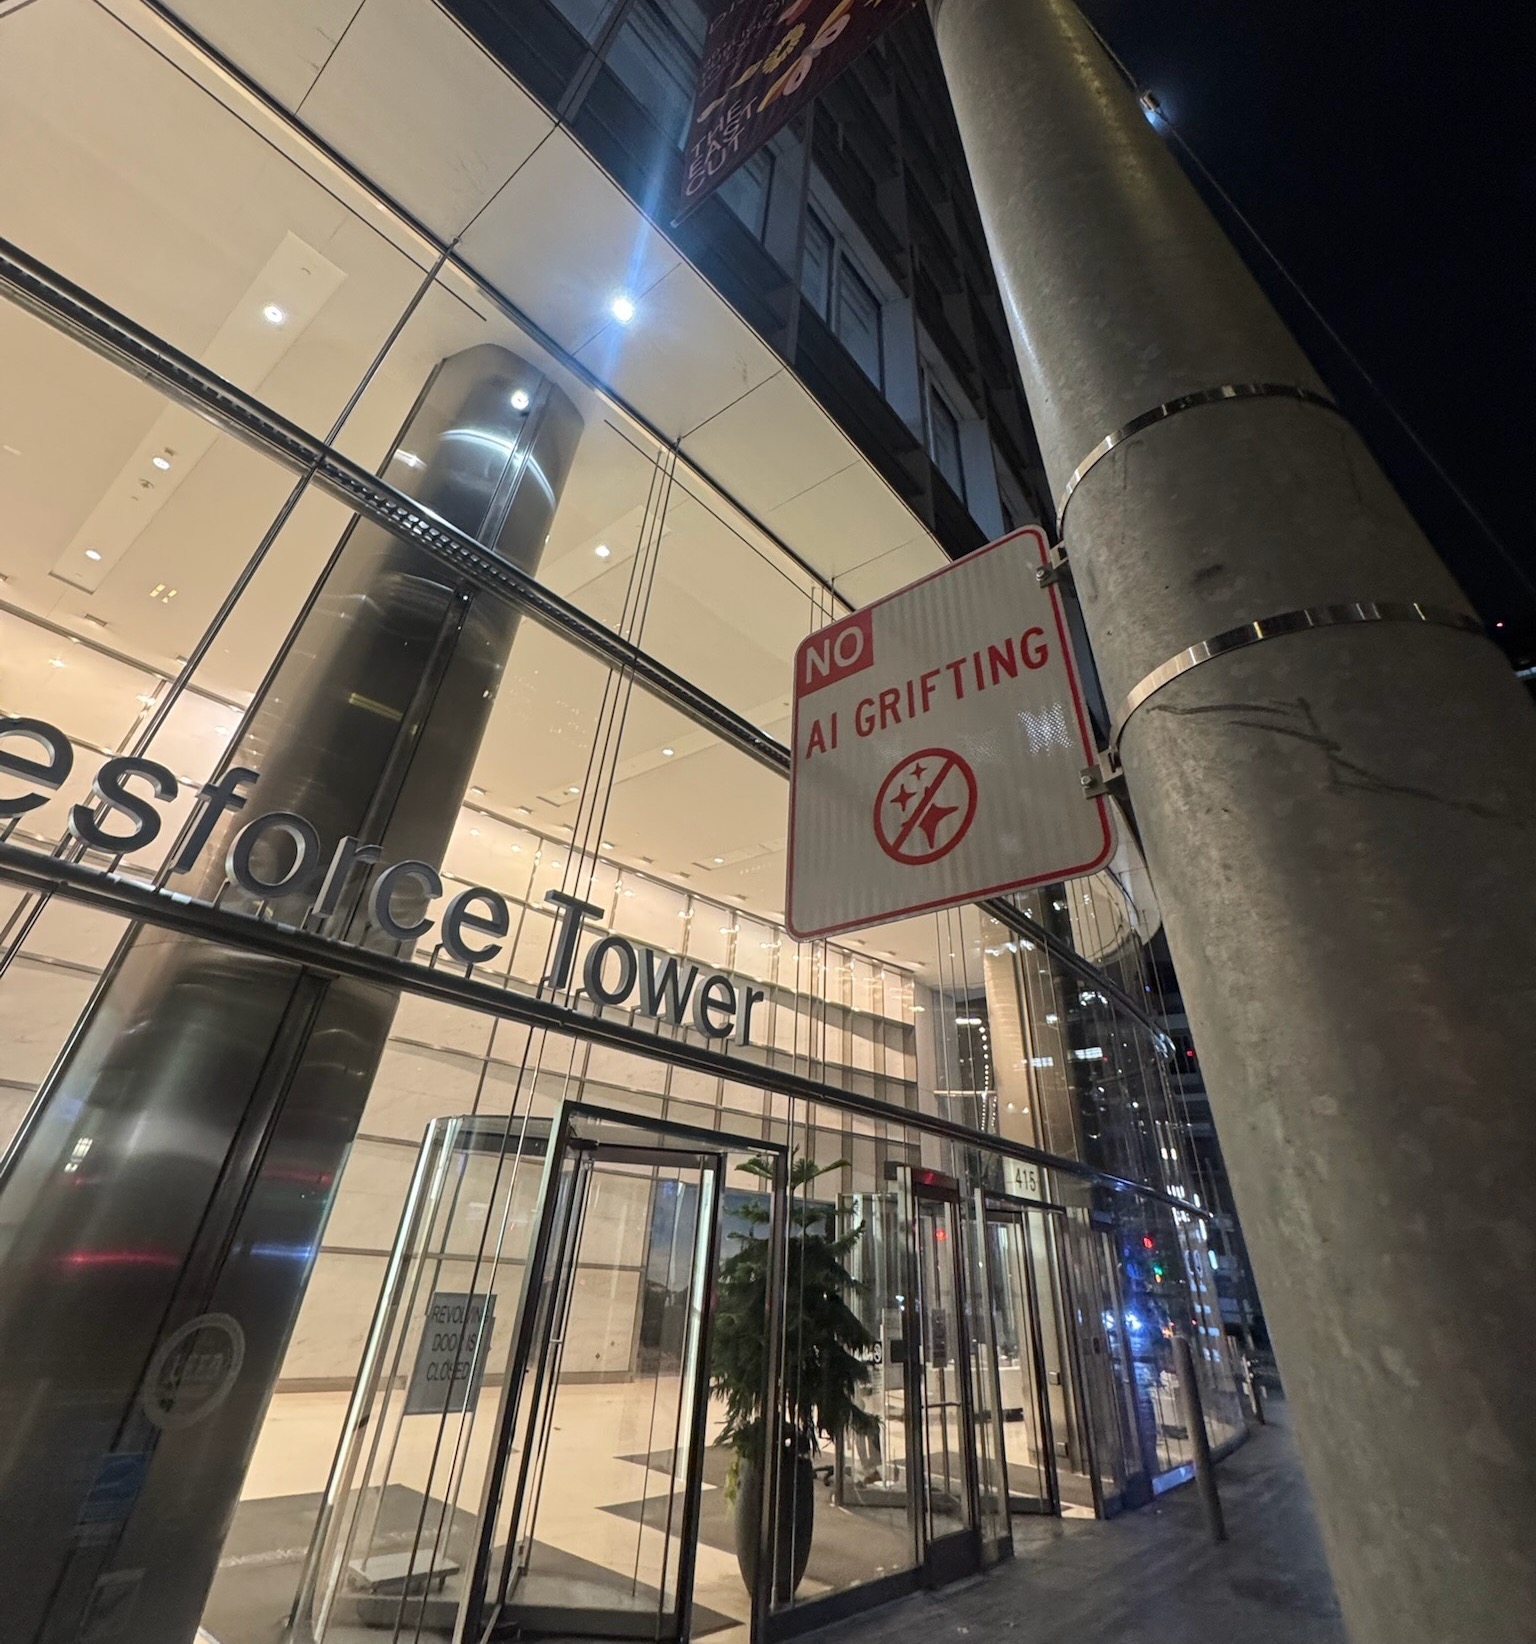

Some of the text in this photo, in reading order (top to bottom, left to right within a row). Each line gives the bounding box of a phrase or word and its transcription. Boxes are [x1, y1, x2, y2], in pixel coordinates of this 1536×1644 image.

[688, 96, 758, 180] EAST
[691, 99, 742, 157] THE
[685, 127, 745, 195] CUT
[804, 625, 864, 685] NO
[805, 627, 1049, 760] AI GRIFTING
[544, 889, 764, 1046] Tower
[1015, 1168, 1036, 1192] 415
[431, 1333, 463, 1351] DOO
